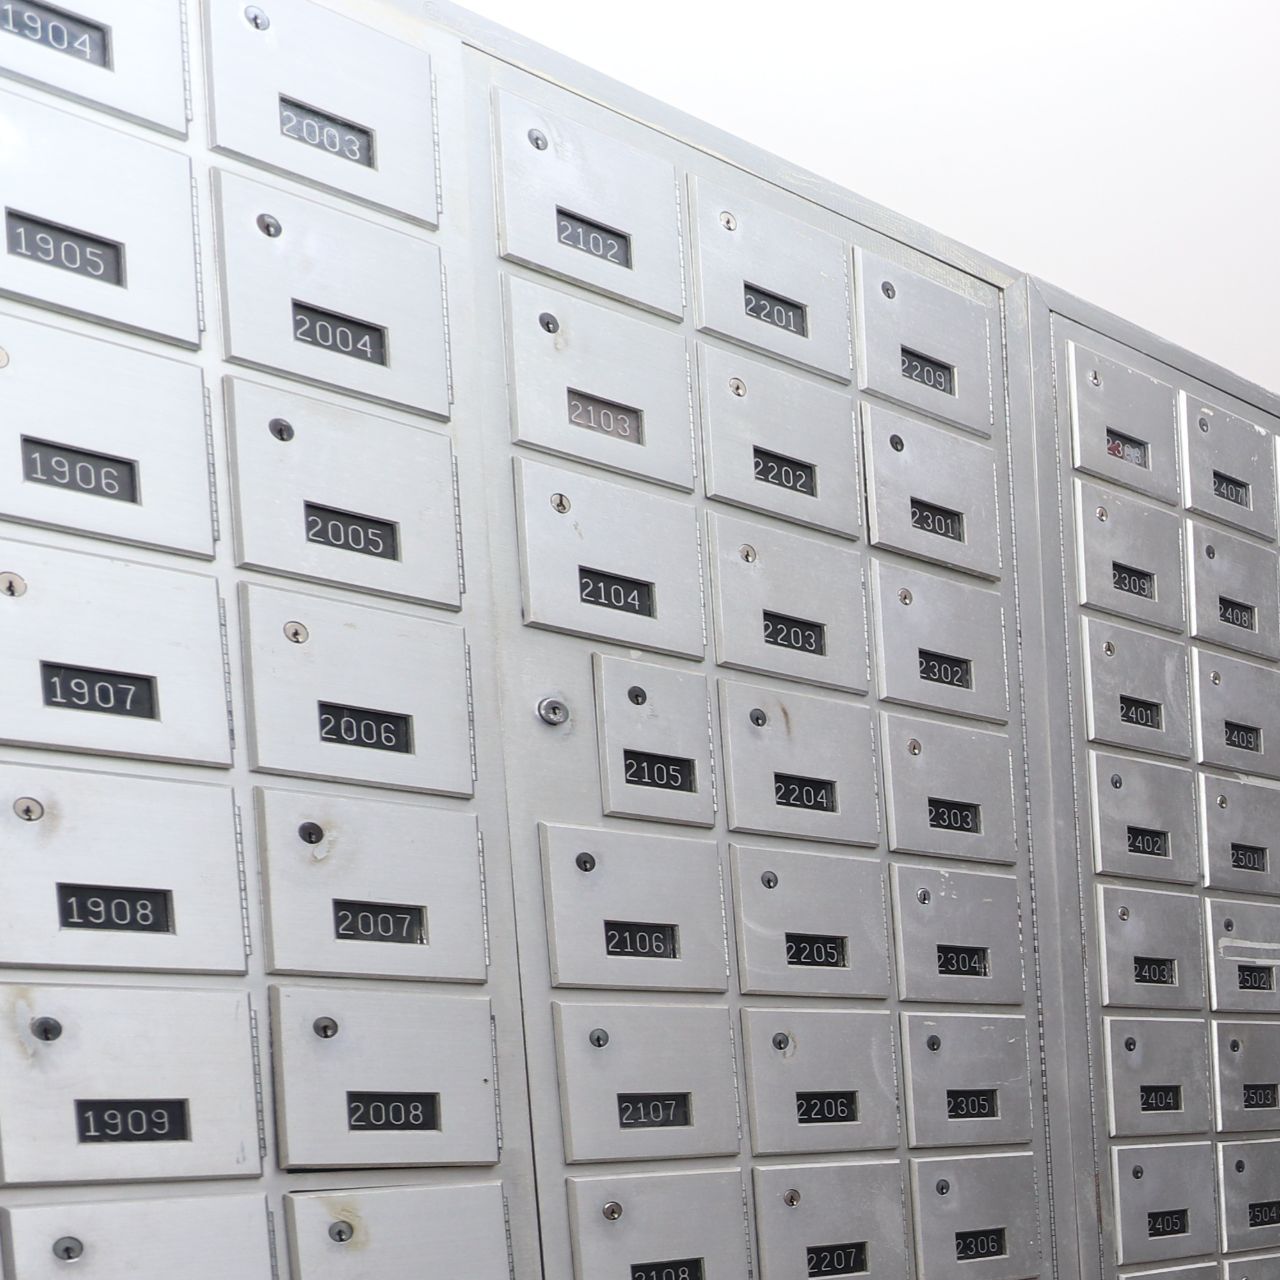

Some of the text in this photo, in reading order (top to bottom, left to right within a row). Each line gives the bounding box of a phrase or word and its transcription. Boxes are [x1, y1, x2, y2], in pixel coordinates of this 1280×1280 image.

[2, 6, 93, 60] 1904
[281, 109, 361, 161] 2003
[16, 225, 105, 276] 1905
[560, 223, 620, 263] 2102
[745, 295, 797, 332] 2201
[295, 314, 373, 359] 2004
[902, 358, 945, 390] 2209
[571, 400, 630, 436] 2103
[31, 451, 120, 495] 1906
[754, 457, 806, 492] 2202
[1213, 479, 1242, 502] 2407
[308, 515, 384, 554] 2005
[911, 508, 955, 537] 2301
[581, 578, 640, 610] 2104
[1113, 571, 1148, 596] 2309
[1219, 605, 1248, 627] 2408
[764, 621, 816, 650] 2203
[918, 659, 963, 686] 2302
[50, 677, 136, 713] 1907
[1120, 705, 1153, 726] 2401
[322, 714, 396, 747] 2006
[1225, 729, 1254, 748] 2409
[625, 759, 682, 786] 2105
[776, 782, 827, 806] 2204
[928, 806, 973, 829] 2303
[1127, 833, 1161, 854] 2402
[1231, 851, 1259, 868] 2501
[67, 897, 155, 926] 1908
[338, 910, 411, 938] 2007
[608, 931, 665, 953] 2106
[787, 942, 838, 963] 2205
[937, 952, 980, 972] 2304
[1134, 964, 1168, 981] 2403
[1238, 972, 1266, 987] 2502
[797, 1099, 848, 1119] 2206
[947, 1096, 988, 1115] 2305
[1141, 1092, 1174, 1108] 2404
[1243, 1089, 1272, 1105] 2503
[84, 1110, 171, 1137] 1909
[350, 1102, 423, 1126] 2008
[622, 1101, 676, 1124] 2107
[1148, 1216, 1181, 1234] 2405
[1249, 1207, 1277, 1224] 2504
[956, 1236, 998, 1257] 2306
[808, 1250, 857, 1272] 2207
